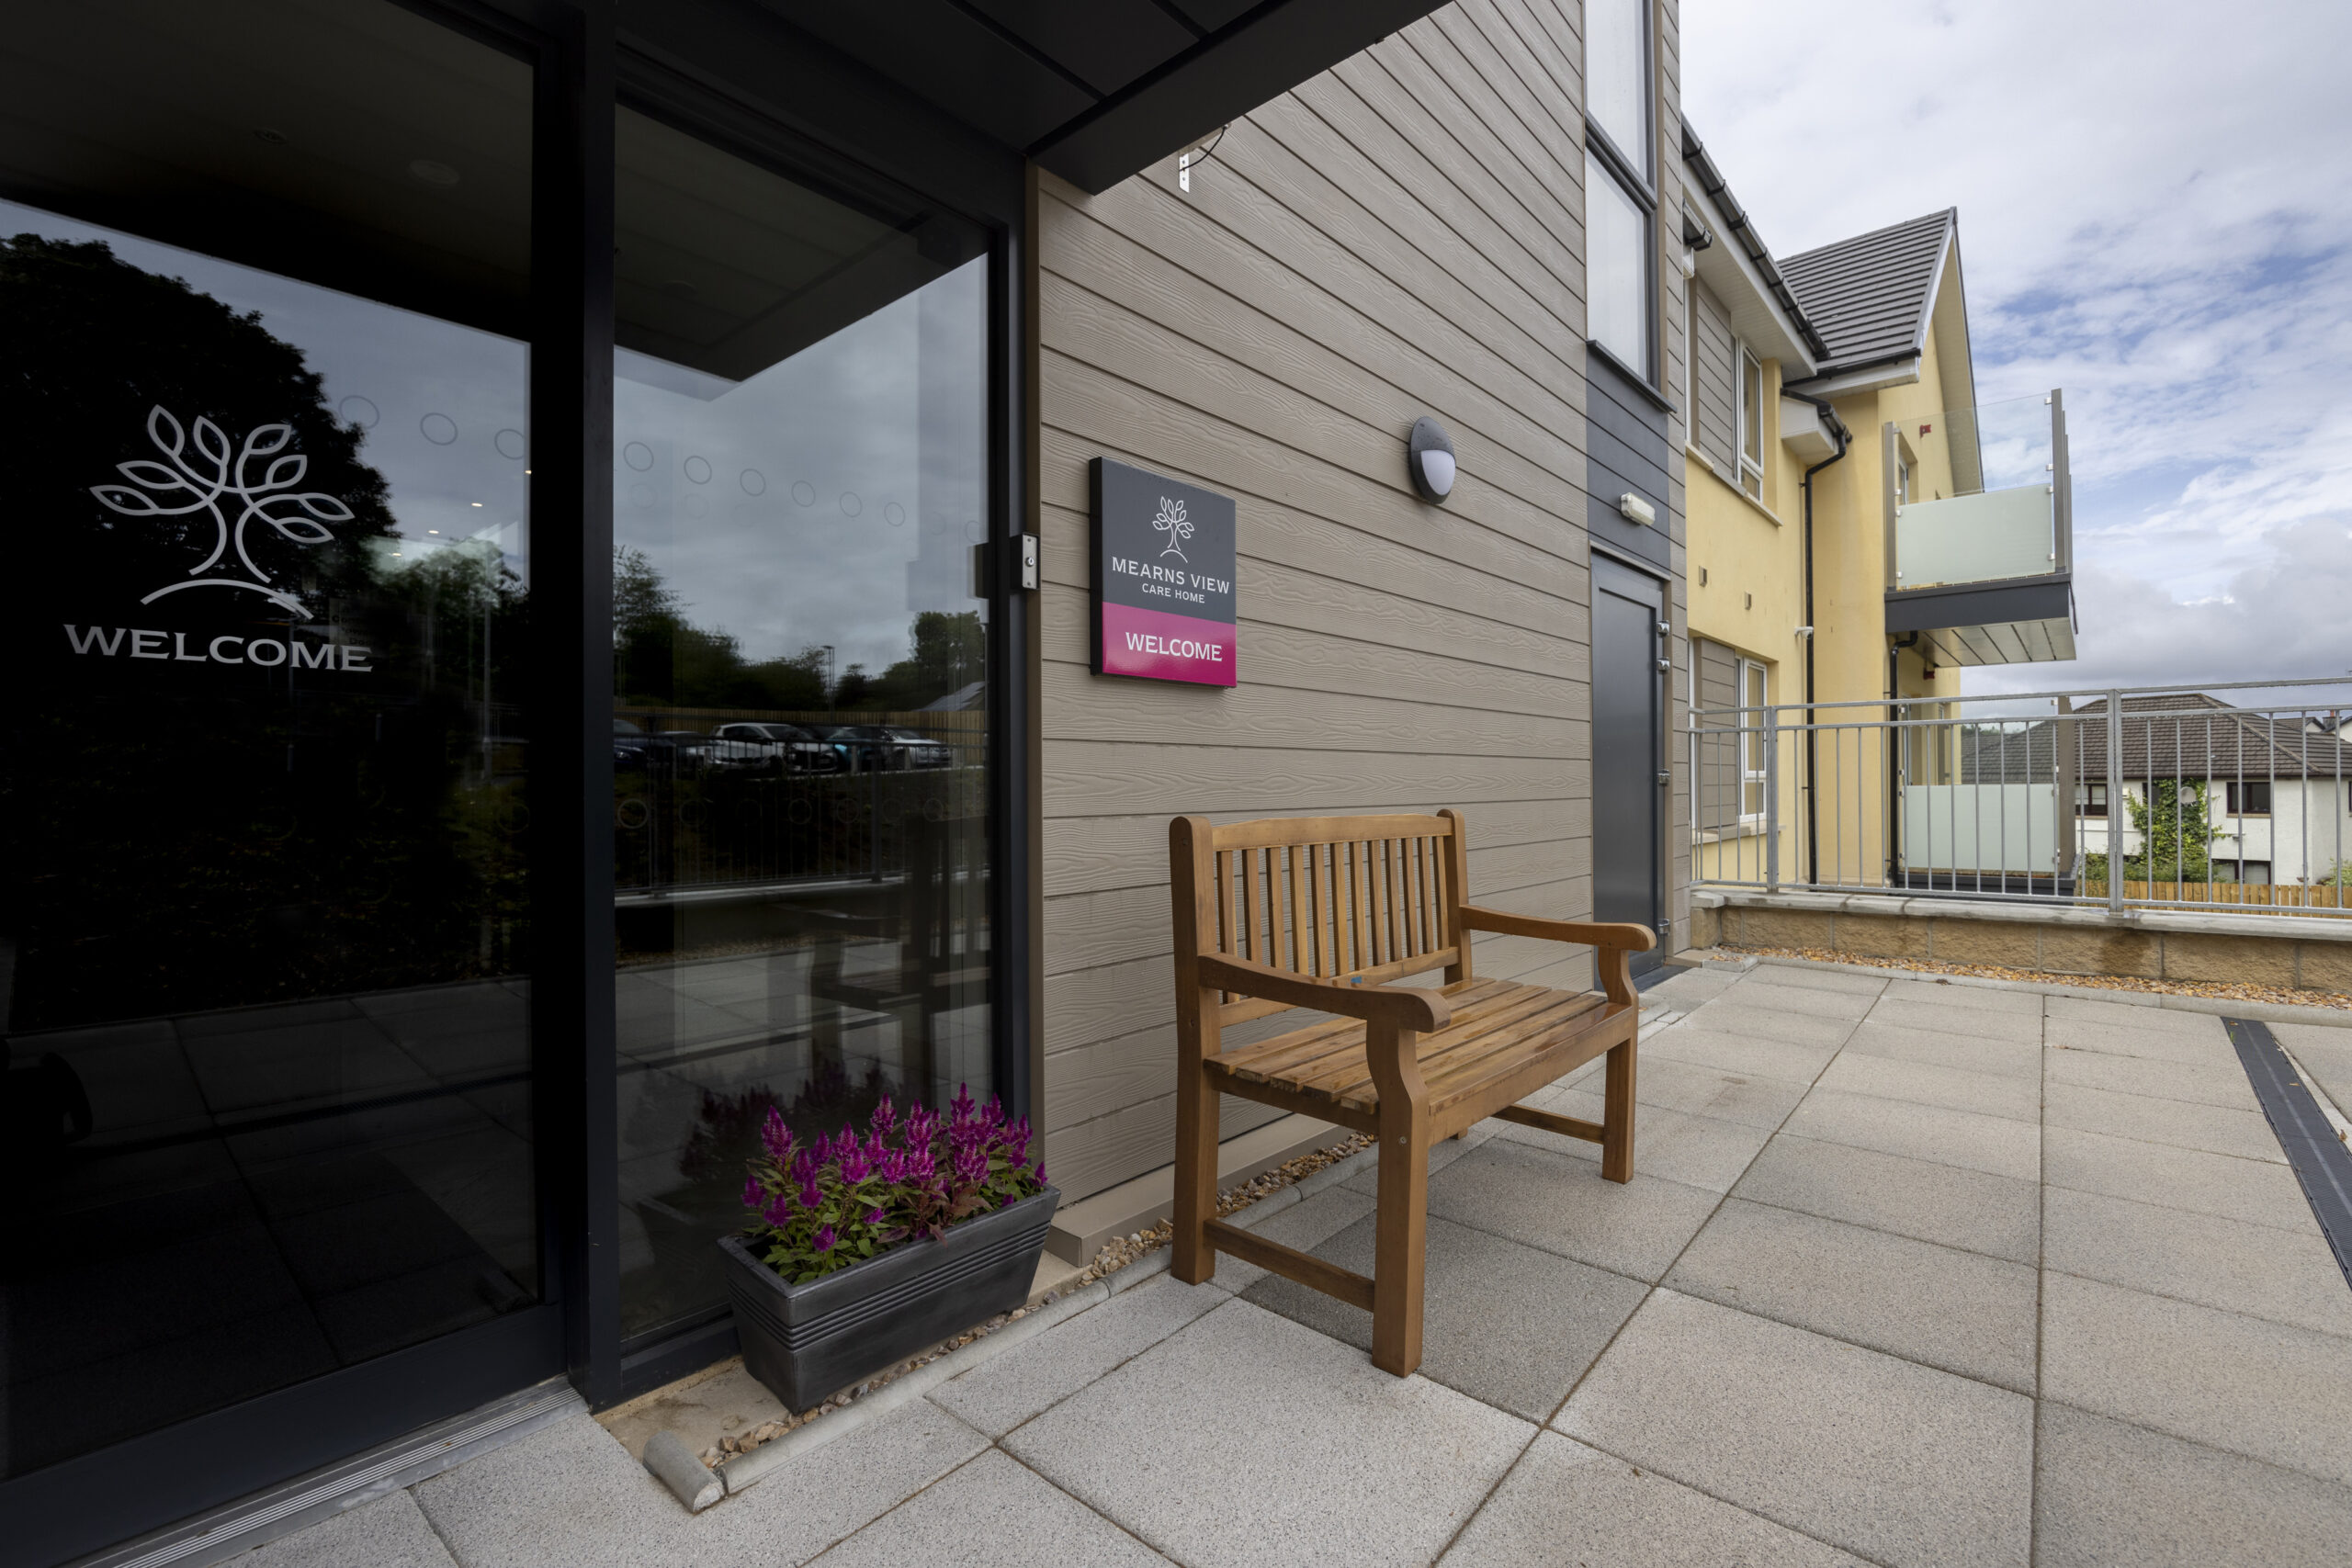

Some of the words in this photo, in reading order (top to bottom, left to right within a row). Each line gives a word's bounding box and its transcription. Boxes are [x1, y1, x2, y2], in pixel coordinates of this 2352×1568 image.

[1112, 557, 1185, 585] MEARNS
[1191, 573, 1230, 594] VIEW
[1142, 583, 1171, 597] CARE
[1174, 590, 1205, 604] HOME
[62, 624, 373, 672] WELCOME
[1125, 631, 1223, 661] WELCOME
